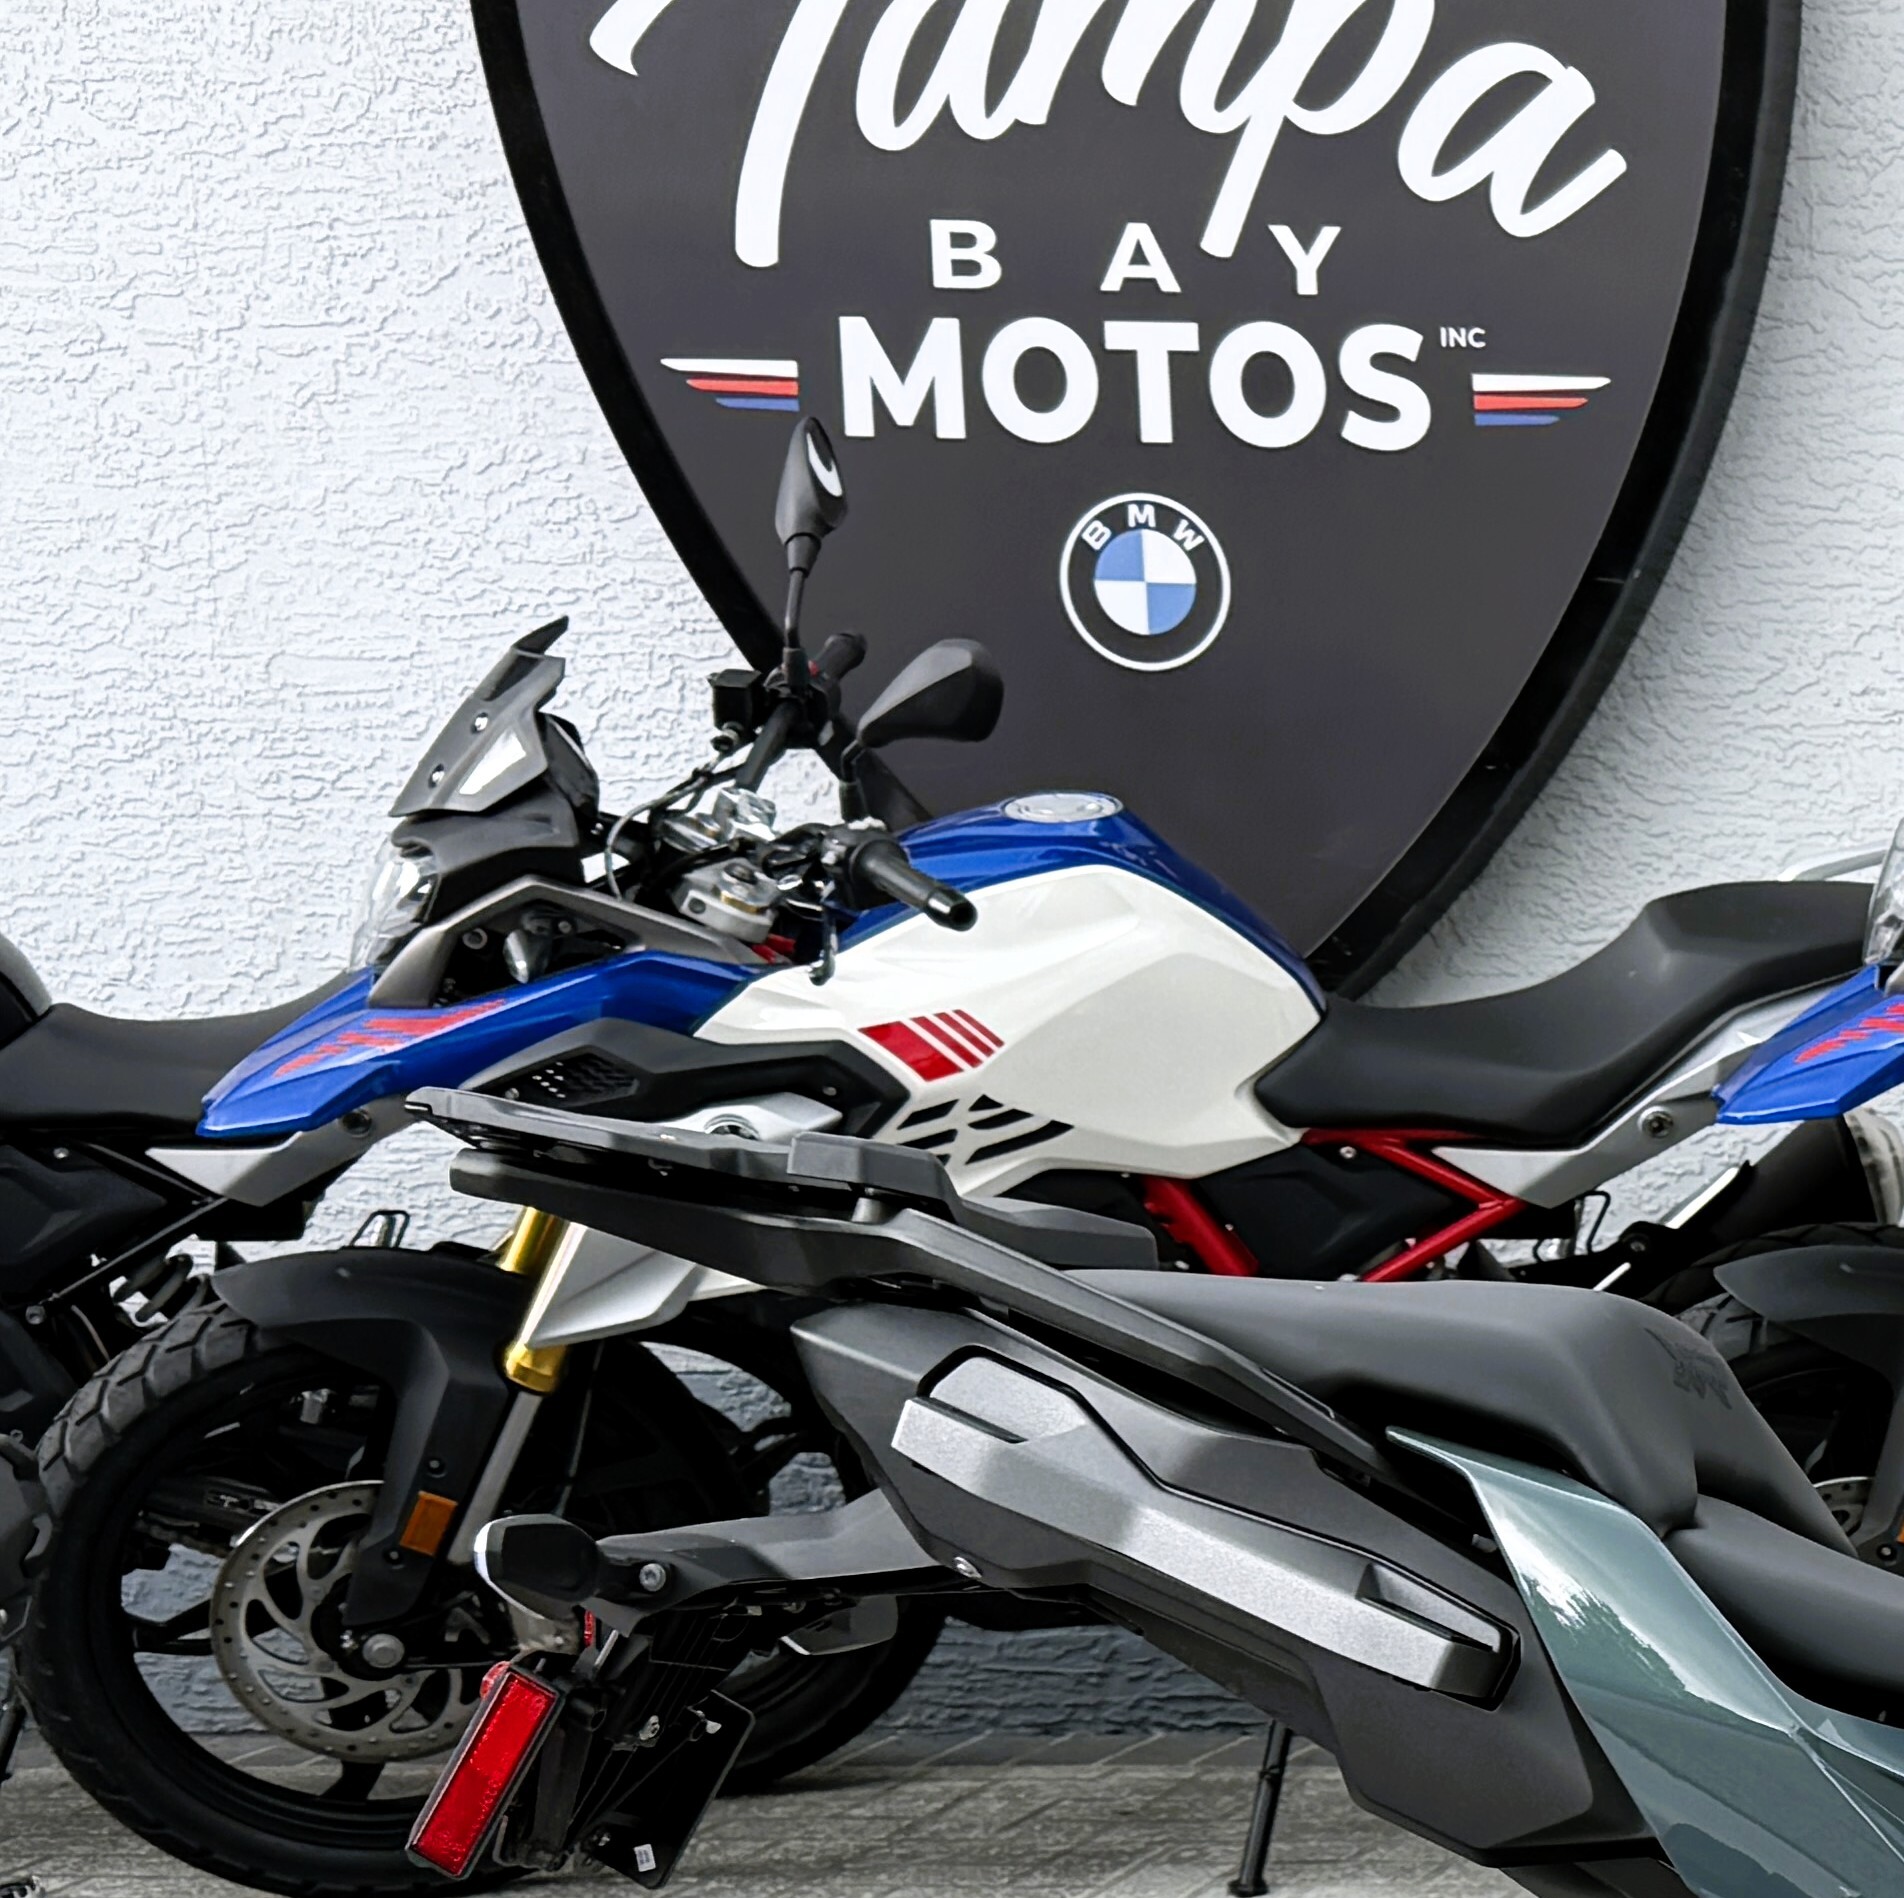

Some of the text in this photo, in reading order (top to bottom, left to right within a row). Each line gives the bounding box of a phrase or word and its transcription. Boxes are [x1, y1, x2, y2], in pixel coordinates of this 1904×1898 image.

[590, 0, 1627, 266] Tampa
[838, 314, 1487, 451] MOTOS INC
[1081, 504, 1205, 551] BMW
